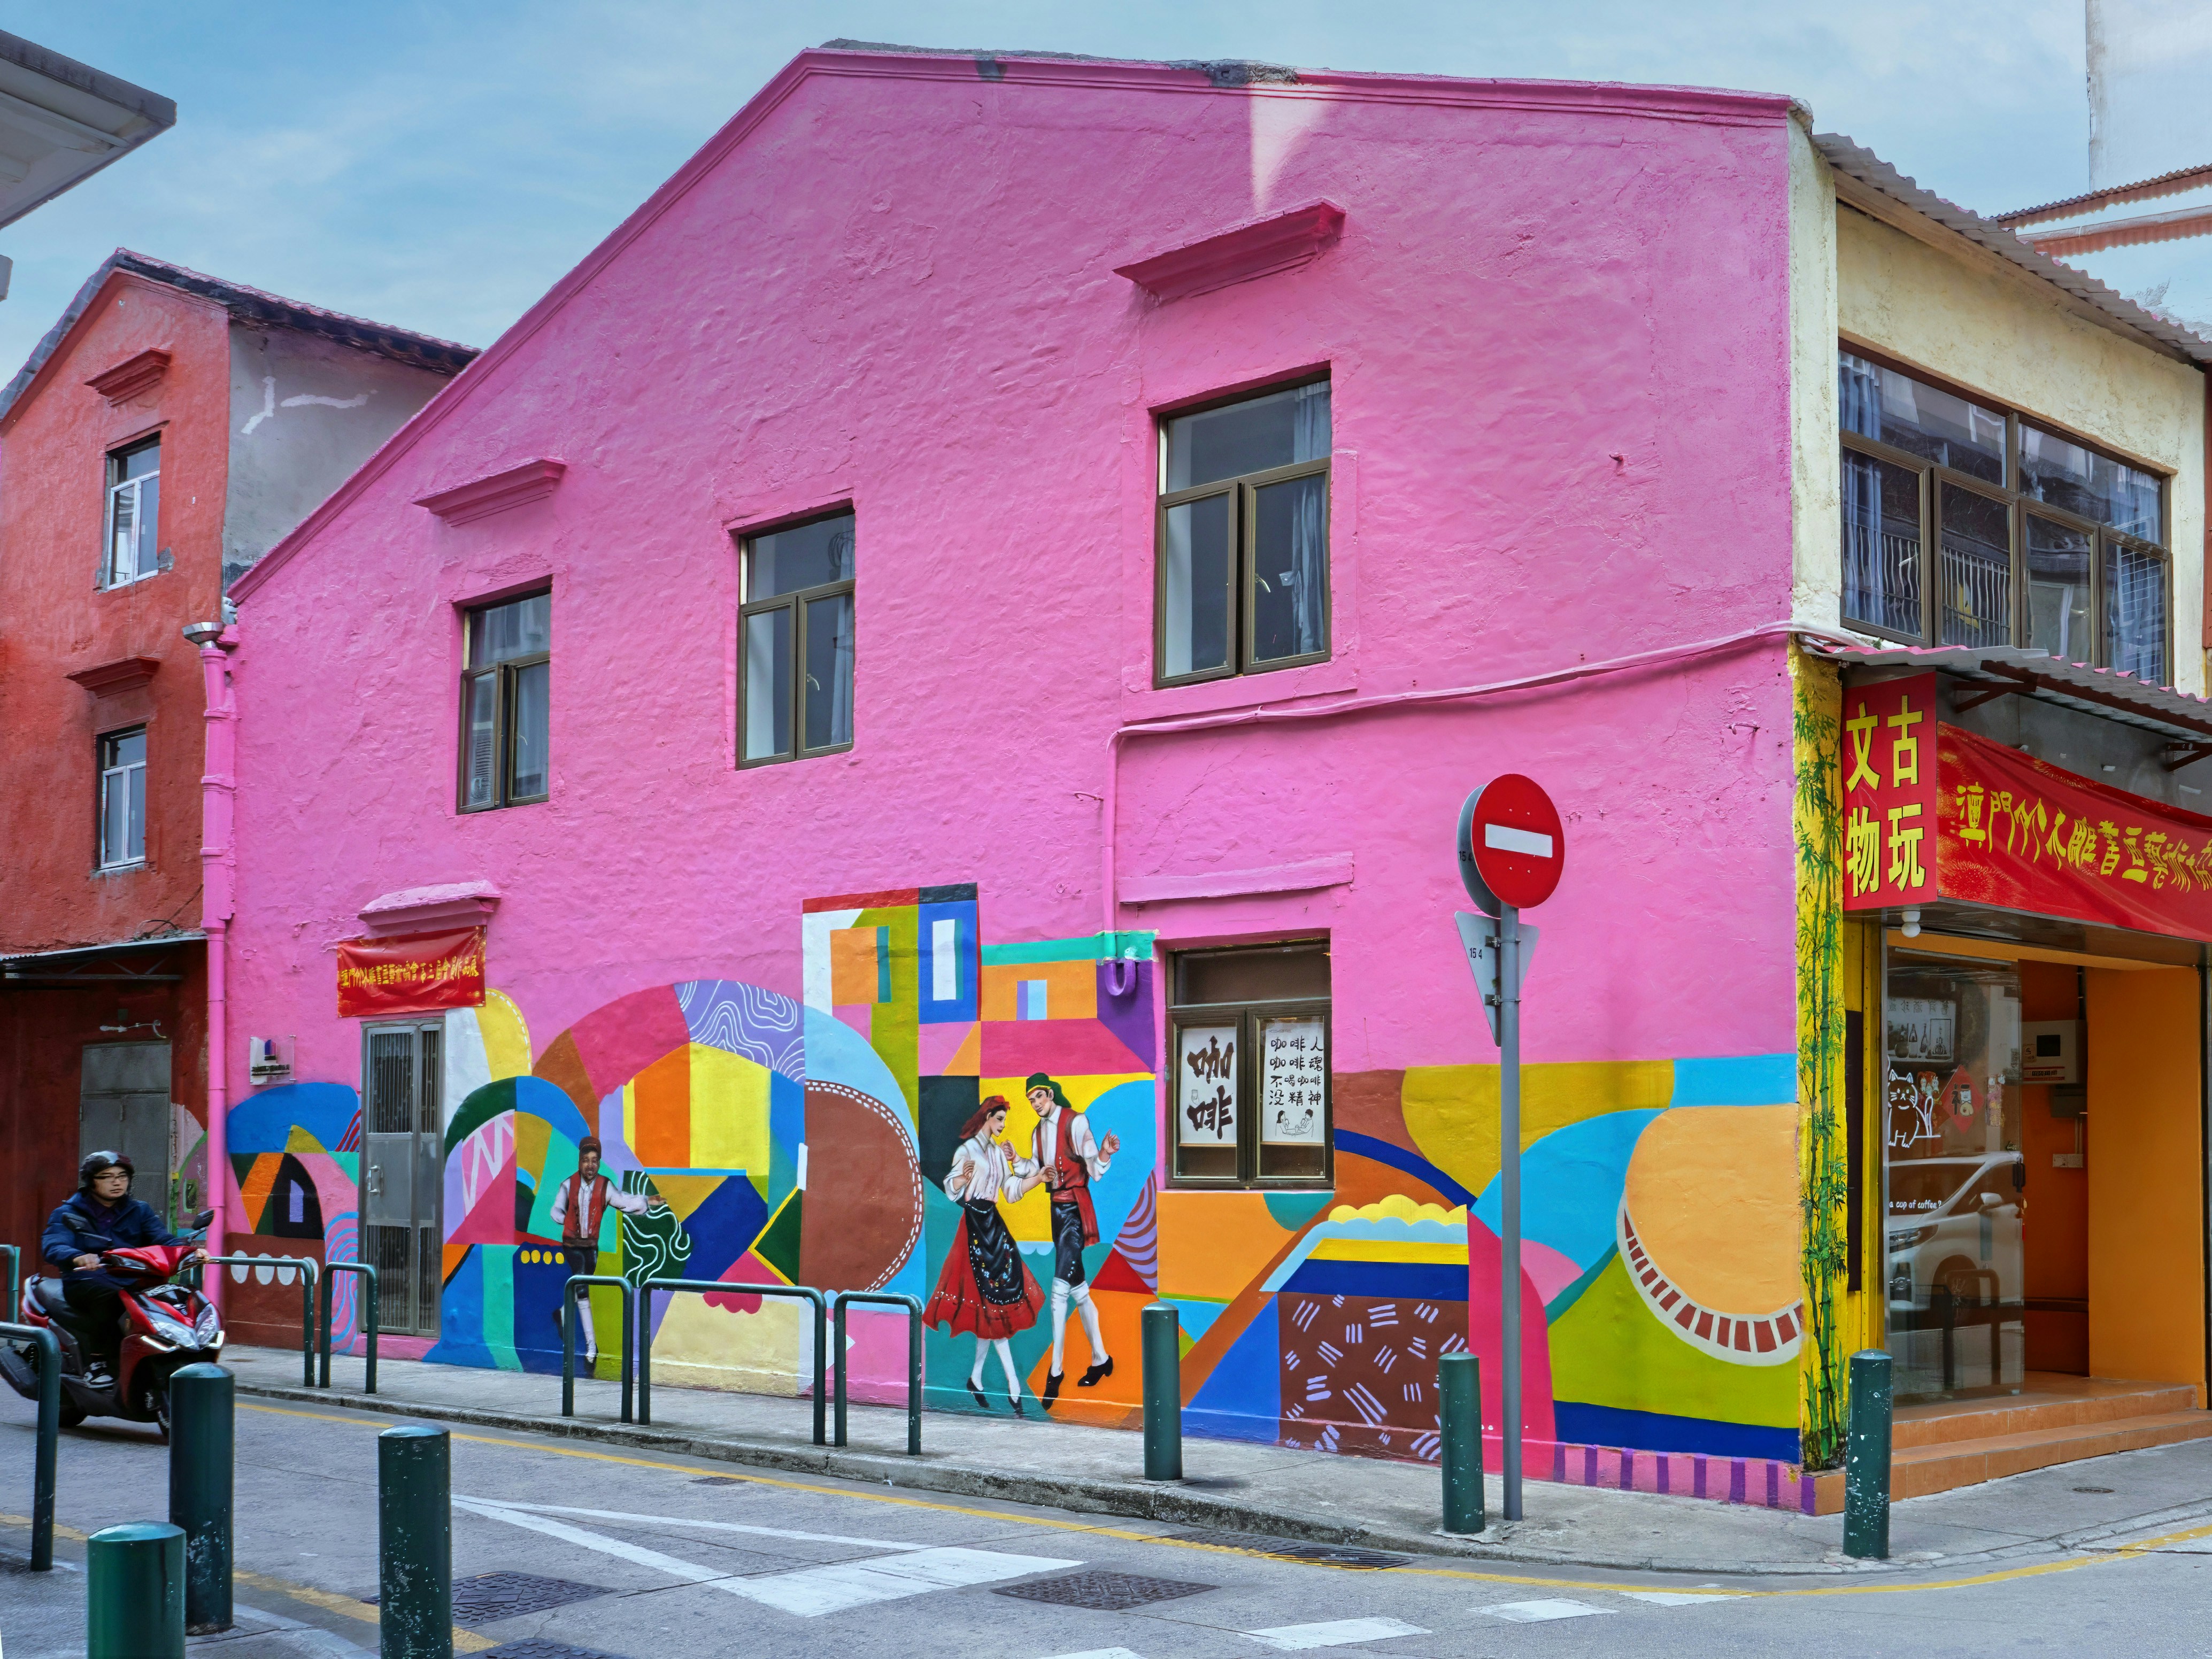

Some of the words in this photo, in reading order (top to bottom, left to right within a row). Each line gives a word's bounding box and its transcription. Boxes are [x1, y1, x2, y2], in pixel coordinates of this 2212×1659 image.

[1846, 701, 1881, 898] 文物
[1887, 695, 1925, 892] 古玩
[1186, 1035, 1234, 1140] 咖啡
[1895, 1201, 1907, 1210] cup
